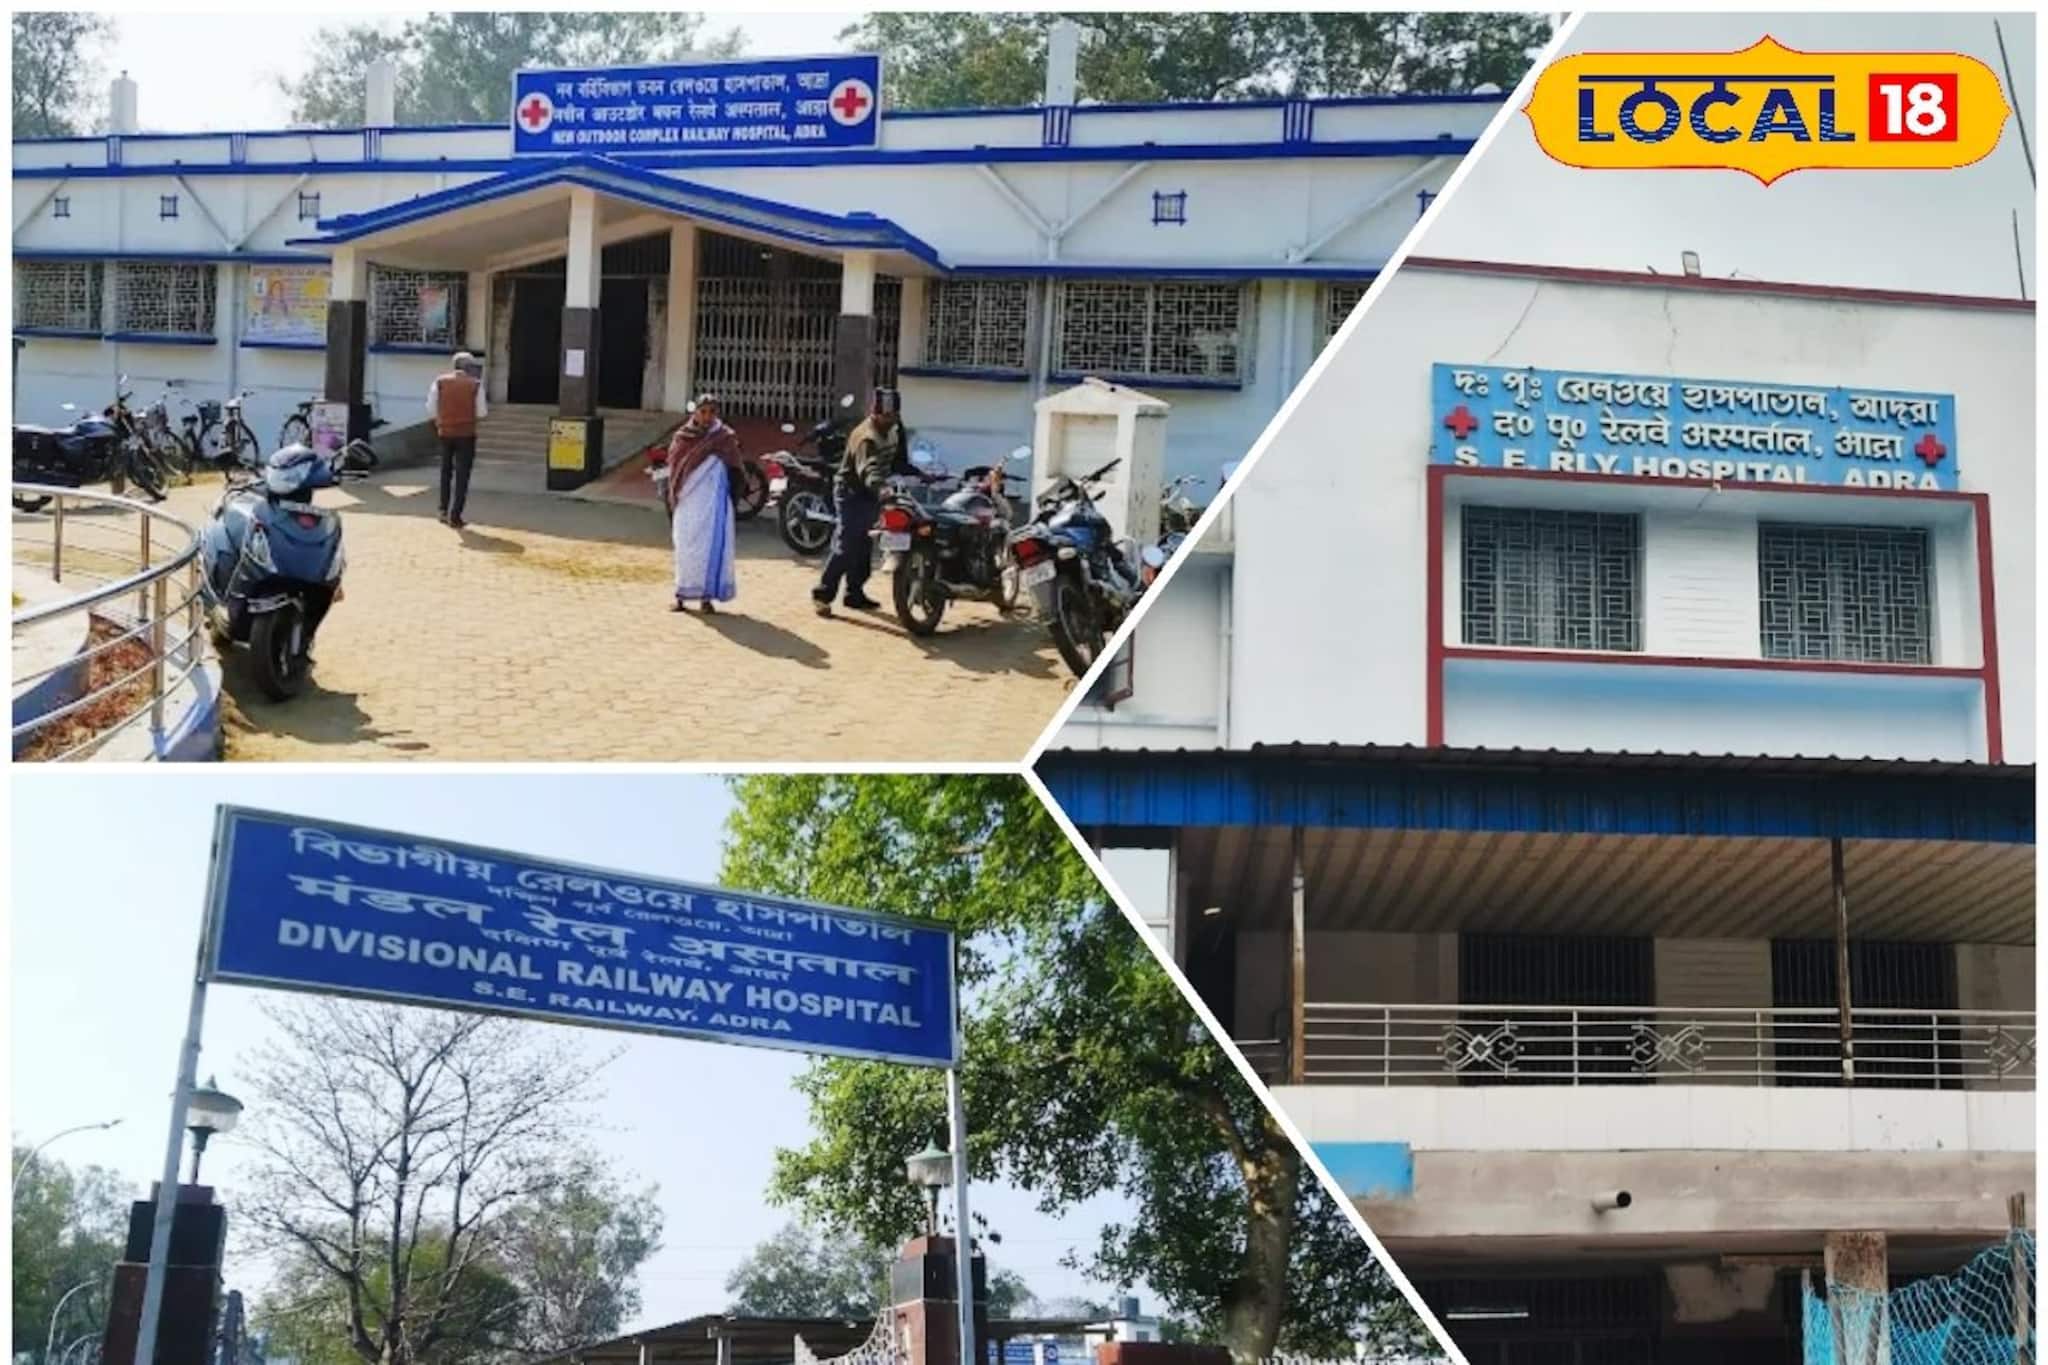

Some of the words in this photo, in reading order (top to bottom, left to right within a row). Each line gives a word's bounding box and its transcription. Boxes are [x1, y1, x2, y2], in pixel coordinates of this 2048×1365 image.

[551, 129, 575, 145] NEW
[575, 128, 628, 144] OUTDOOR
[628, 127, 680, 143] COMPLEX
[681, 125, 731, 142] RAILWAY
[731, 123, 792, 142] HOSPITAL,
[793, 122, 828, 139] ADRA
[1599, 407, 1672, 444] रेलवे
[1844, 468, 1941, 491] ADRA
[289, 827, 497, 882] বিভাগীয়
[713, 897, 914, 946] হাসপাতাল
[286, 874, 495, 925] मंडल
[521, 903, 636, 946] रेल
[669, 935, 919, 985] अस्पताल
[277, 918, 544, 981] DIVISIONAL
[557, 959, 734, 1005] RAILWAY
[746, 984, 922, 1029] HOSPITAL
[472, 980, 537, 1003] S.E.
[708, 1012, 793, 1033] ADRA
